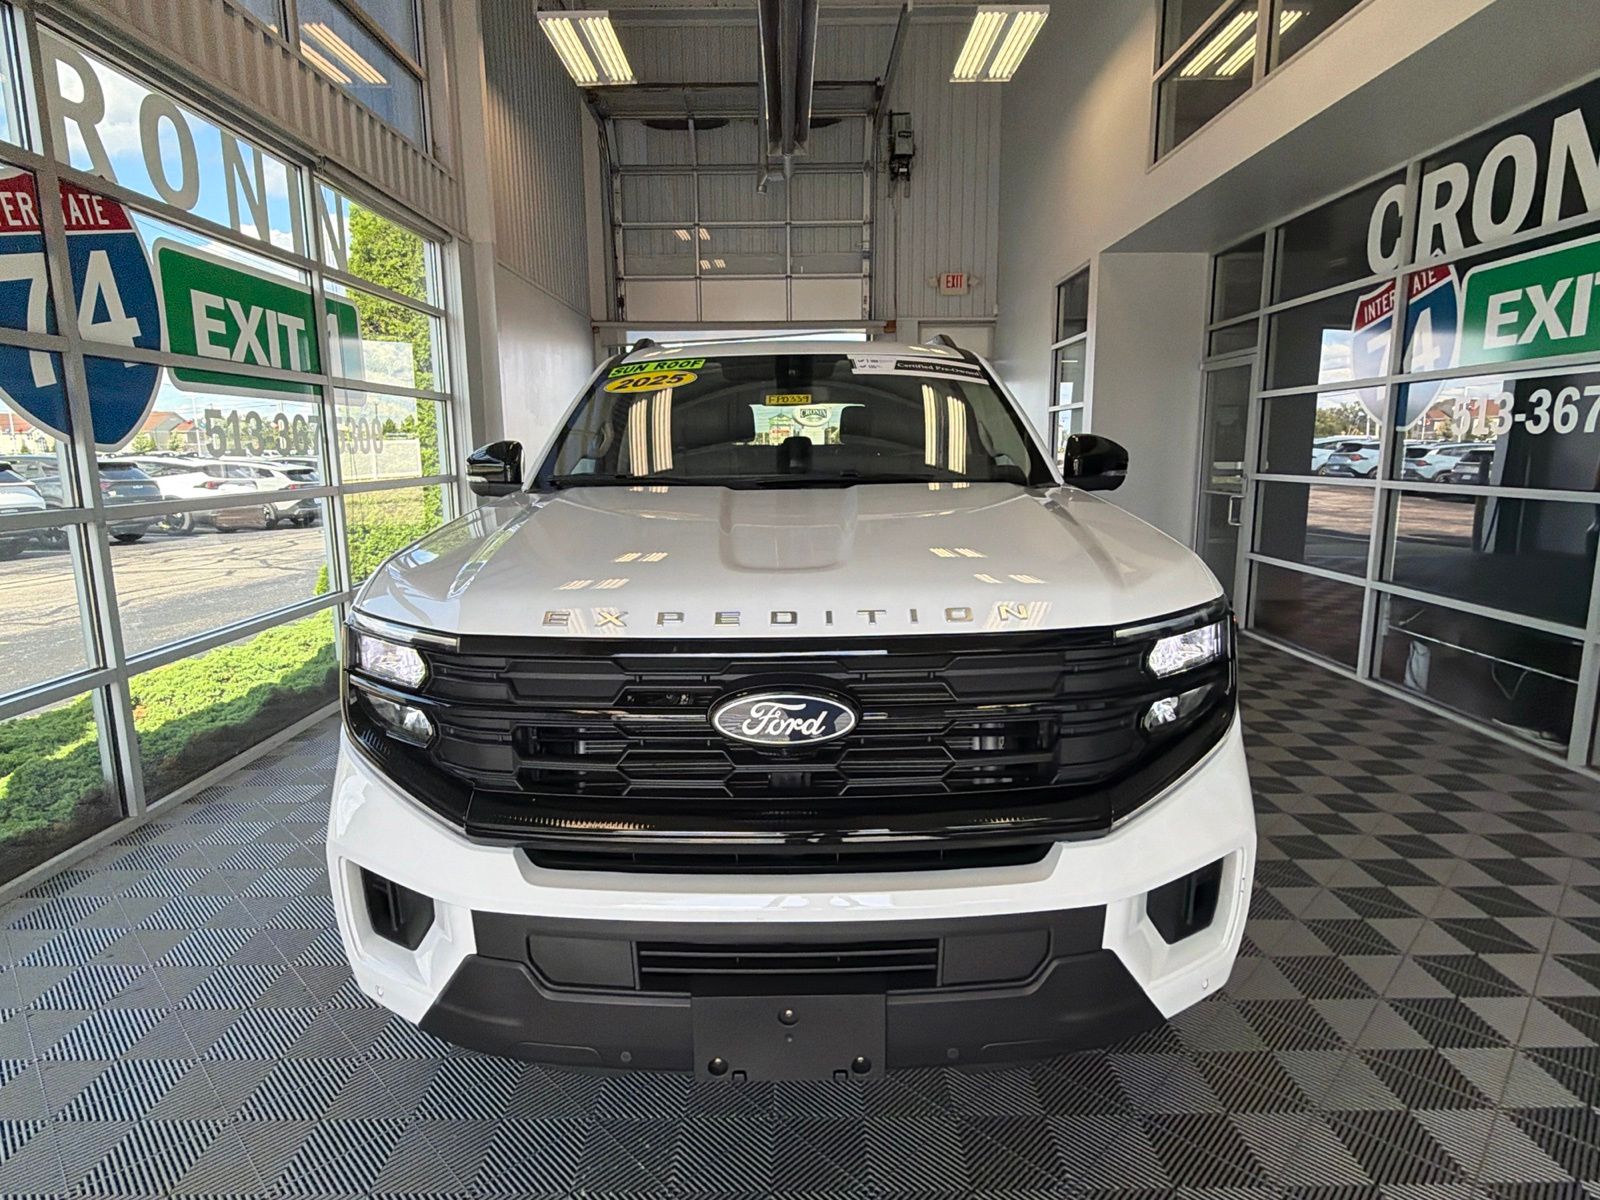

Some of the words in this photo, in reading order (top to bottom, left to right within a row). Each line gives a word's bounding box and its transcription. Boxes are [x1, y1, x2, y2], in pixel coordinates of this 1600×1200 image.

[945, 274, 963, 289] EXIT
[0, 249, 142, 388] 74
[1483, 272, 1600, 350] EXI
[190, 288, 306, 372] EXIT
[611, 363, 650, 376] SUN
[653, 360, 703, 371] ROOF
[897, 362, 934, 371] Certified
[935, 365, 980, 377] Pre-Owned
[613, 374, 687, 390] 2025
[541, 603, 1029, 627] EXPEDITION
[741, 701, 829, 736] Ford
